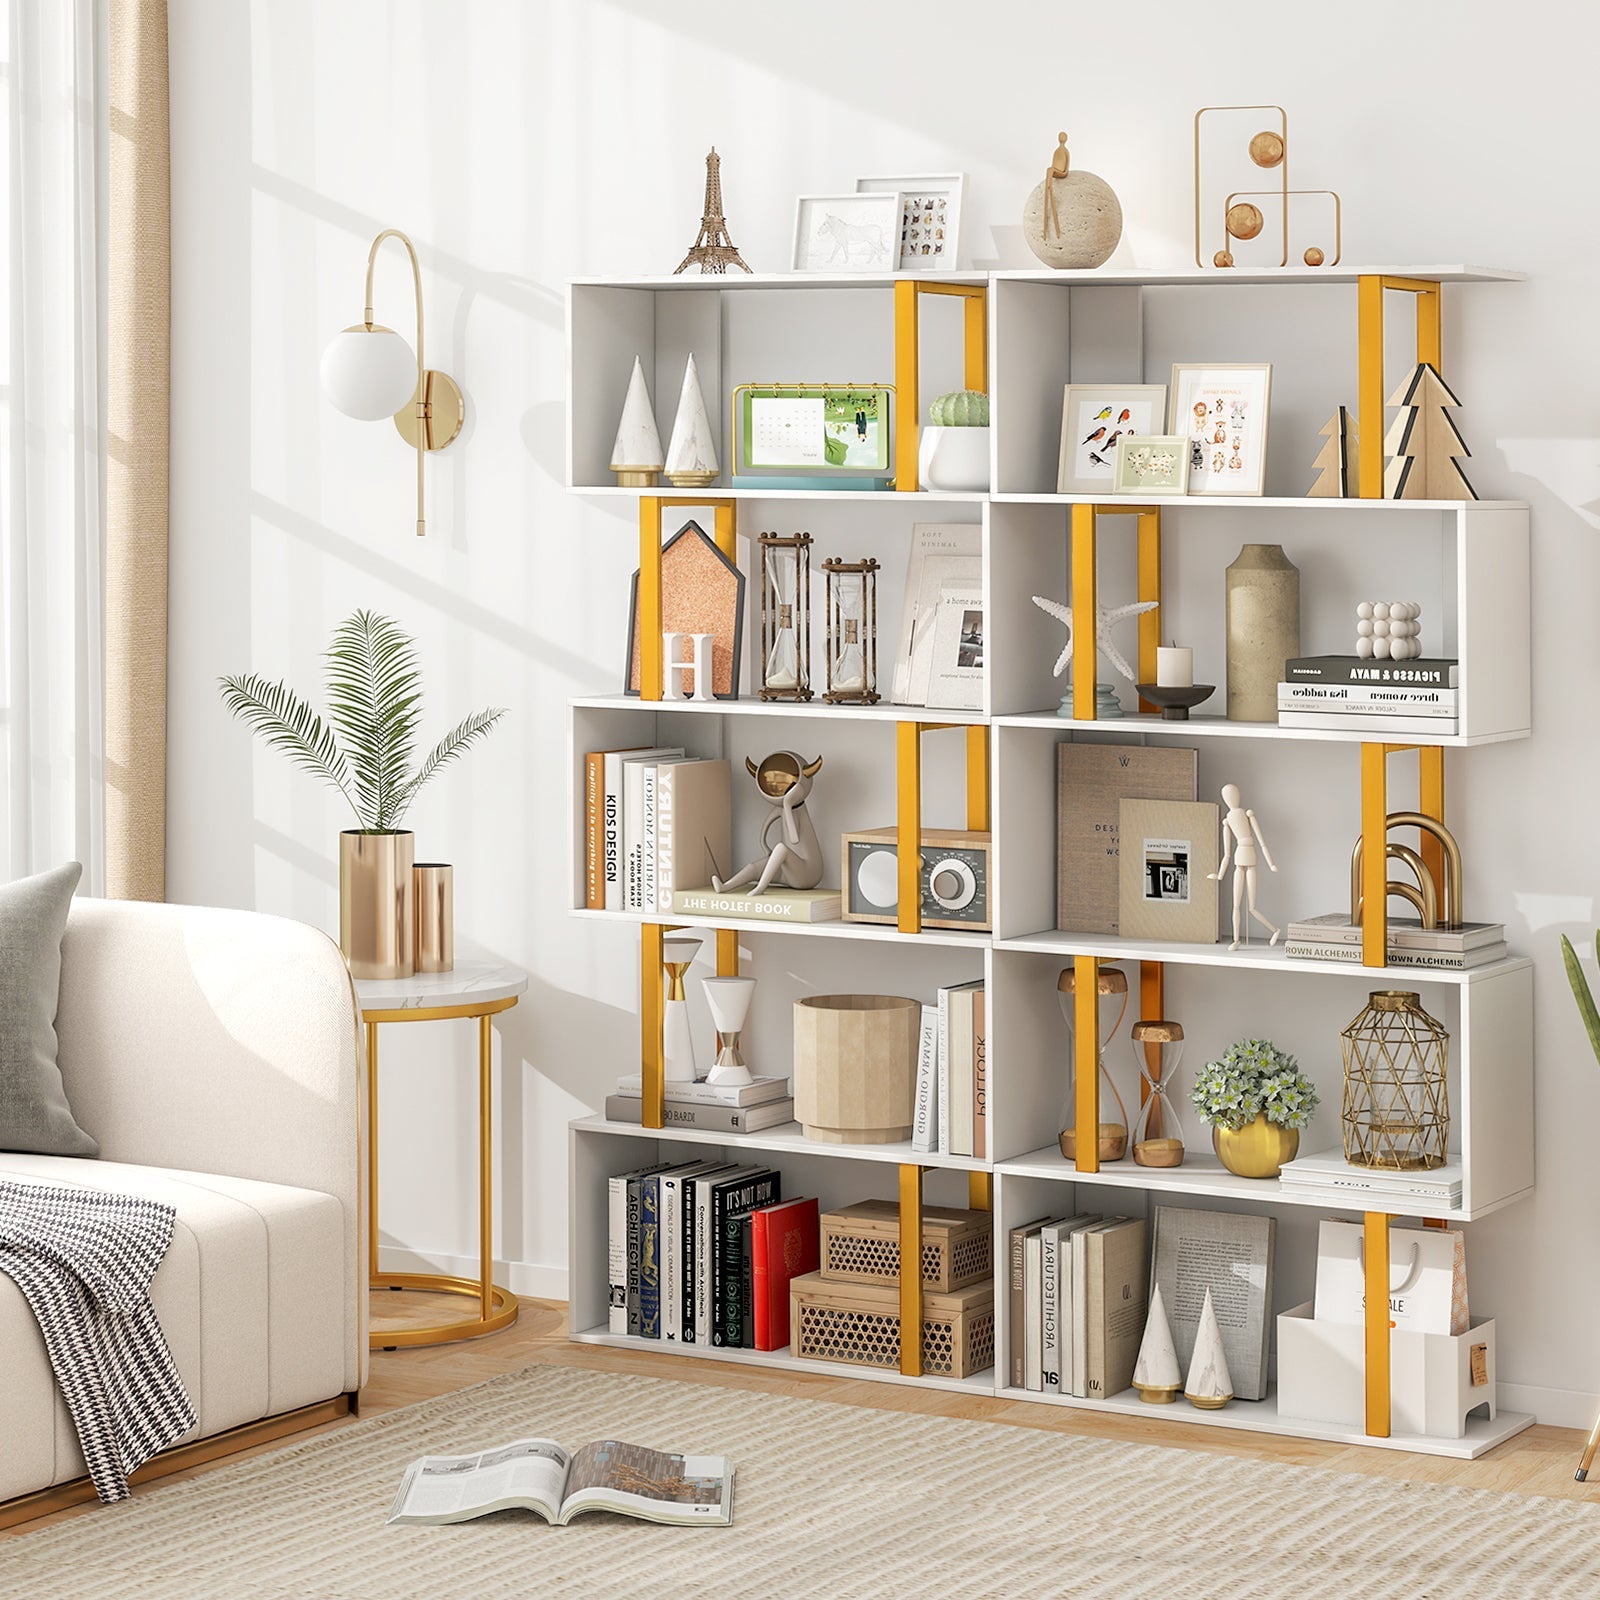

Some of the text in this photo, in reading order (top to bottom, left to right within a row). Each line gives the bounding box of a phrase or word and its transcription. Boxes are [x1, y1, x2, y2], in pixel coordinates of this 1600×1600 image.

[662, 632, 718, 700] H
[589, 762, 597, 805] simplicity
[589, 827, 597, 871] everything
[606, 795, 617, 882] KIDS DESIGN
[1314, 947, 1362, 959] ALCHEMIST
[726, 1190, 740, 1211] IT'S
[741, 1185, 755, 1206] NOT
[629, 1195, 639, 1295] ARCHITECTURE
